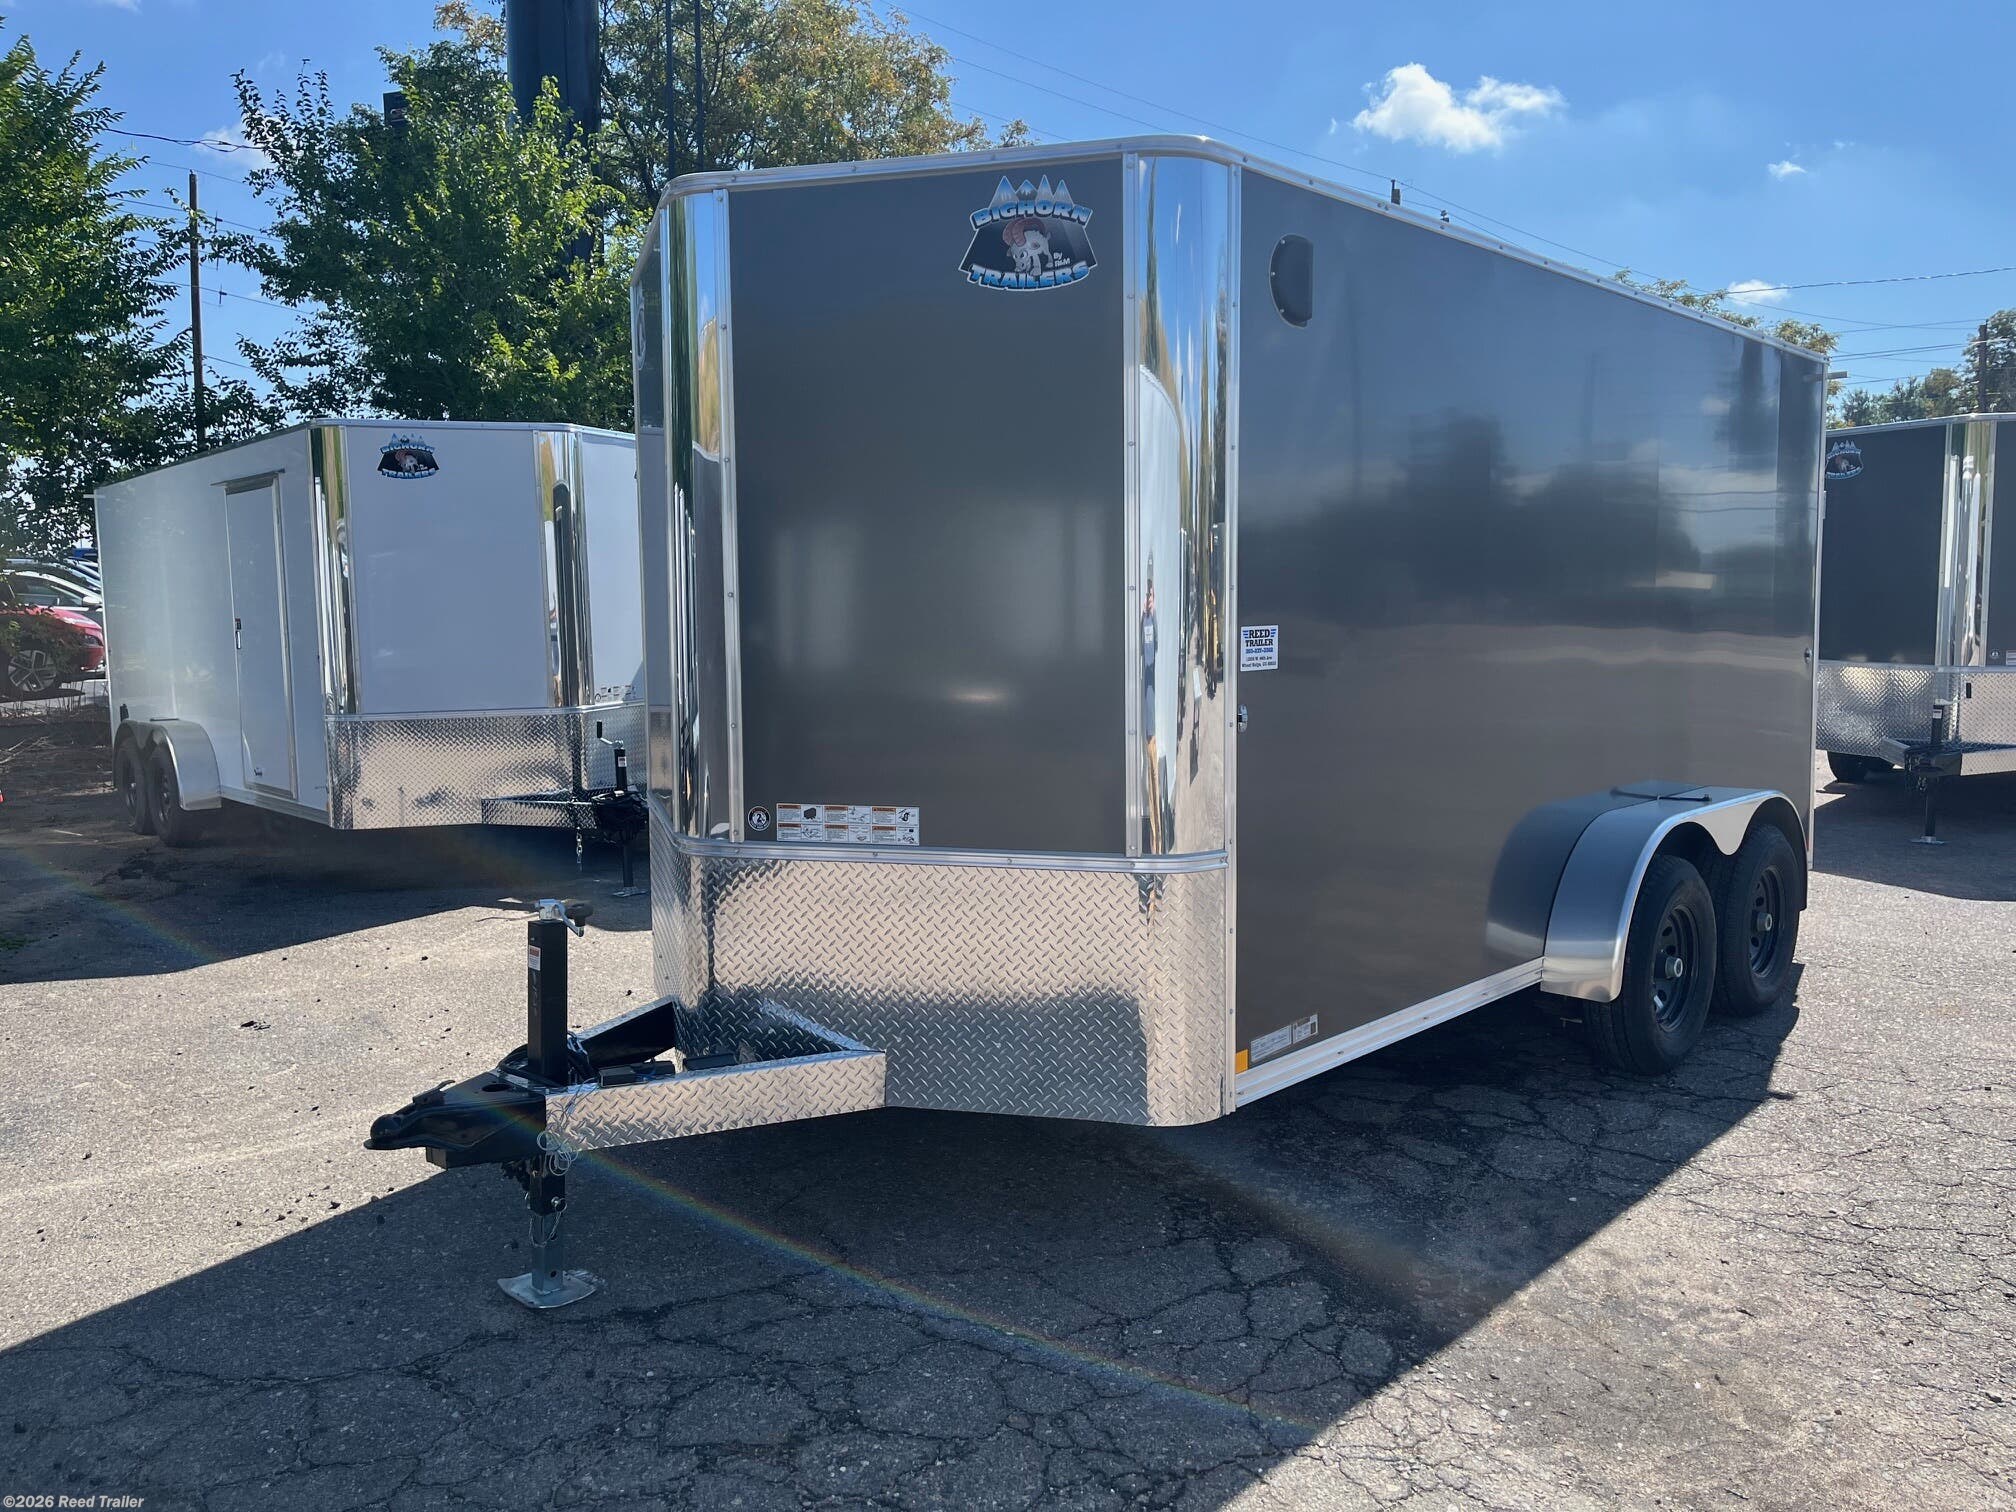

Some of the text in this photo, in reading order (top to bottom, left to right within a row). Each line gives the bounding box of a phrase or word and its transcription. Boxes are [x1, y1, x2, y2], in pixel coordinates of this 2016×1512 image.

[971, 199, 1093, 228] BIGHORN
[969, 260, 1091, 289] TRAILERS
[1249, 628, 1271, 638] REED
[1245, 639, 1274, 647] TRAILER
